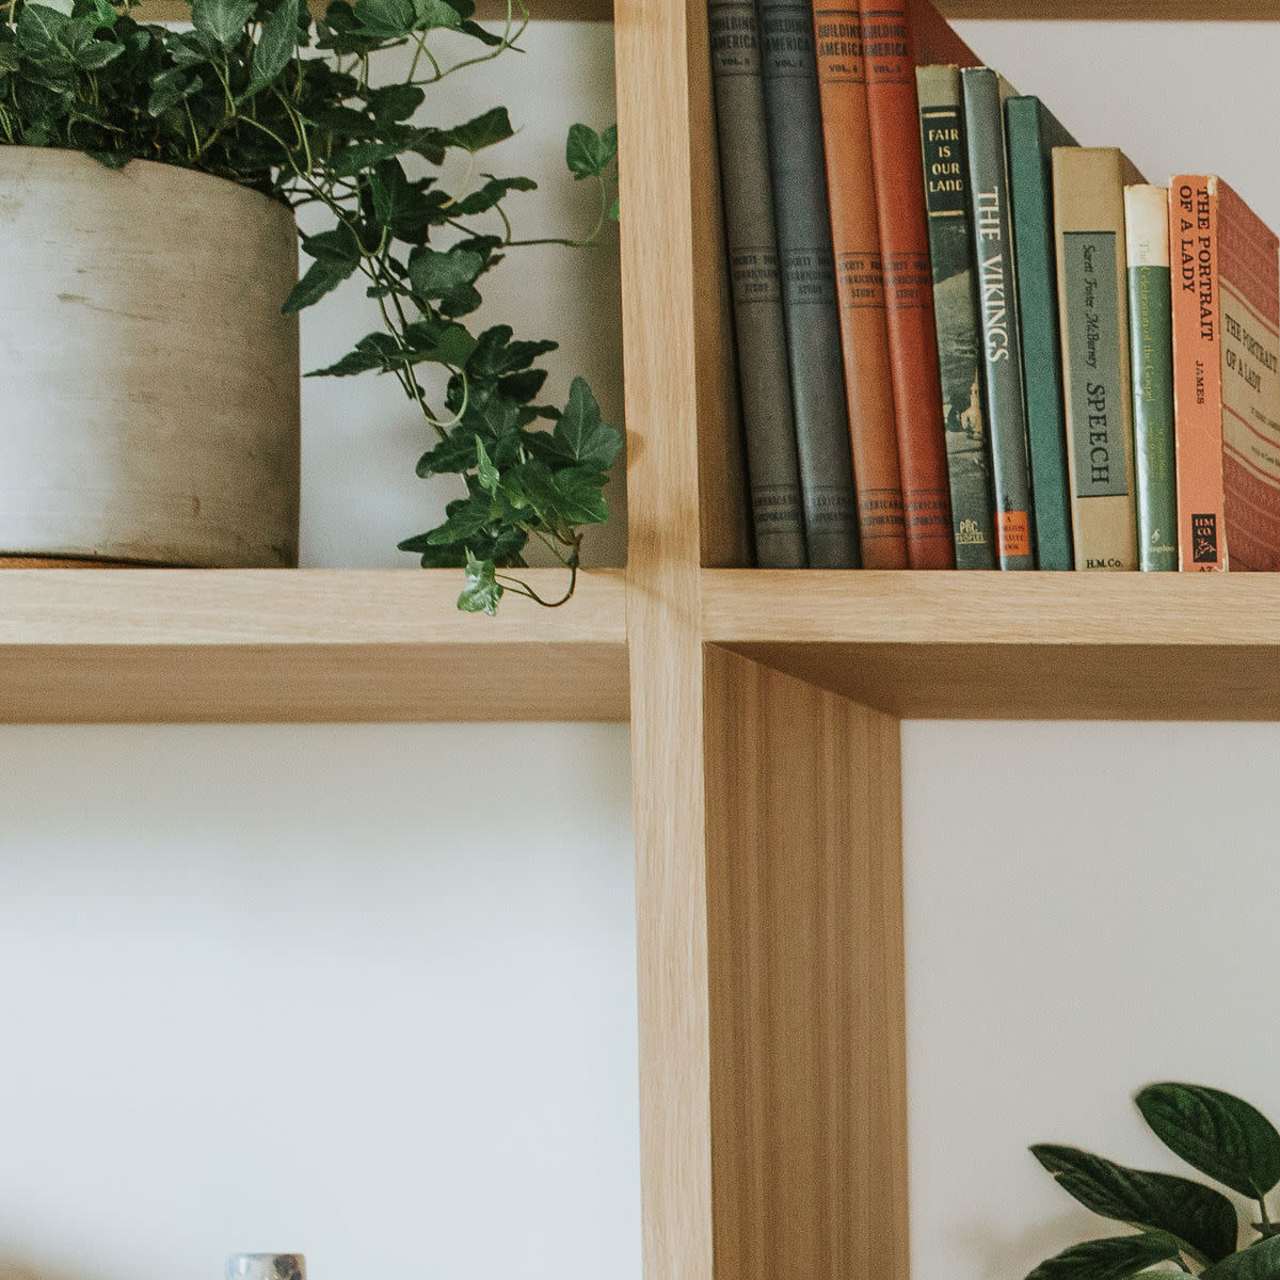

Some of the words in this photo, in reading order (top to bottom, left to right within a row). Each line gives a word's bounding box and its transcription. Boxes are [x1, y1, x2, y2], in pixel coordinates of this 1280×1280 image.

[928, 128, 959, 141] FAIR
[938, 146, 952, 158] IS
[929, 180, 963, 193] LAND
[932, 163, 960, 176] OUR
[976, 186, 1000, 241] THE
[1180, 185, 1194, 213] OF
[1196, 187, 1210, 229] THE
[1180, 218, 1194, 232] A
[1181, 239, 1196, 294] LADY
[1198, 237, 1214, 342] PORTRAIT
[982, 255, 1009, 363] VIKINGS
[1224, 313, 1241, 344] THE
[1241, 328, 1278, 374] PORTRAIT
[1225, 348, 1237, 372] OF
[1086, 383, 1110, 485] SPEECH
